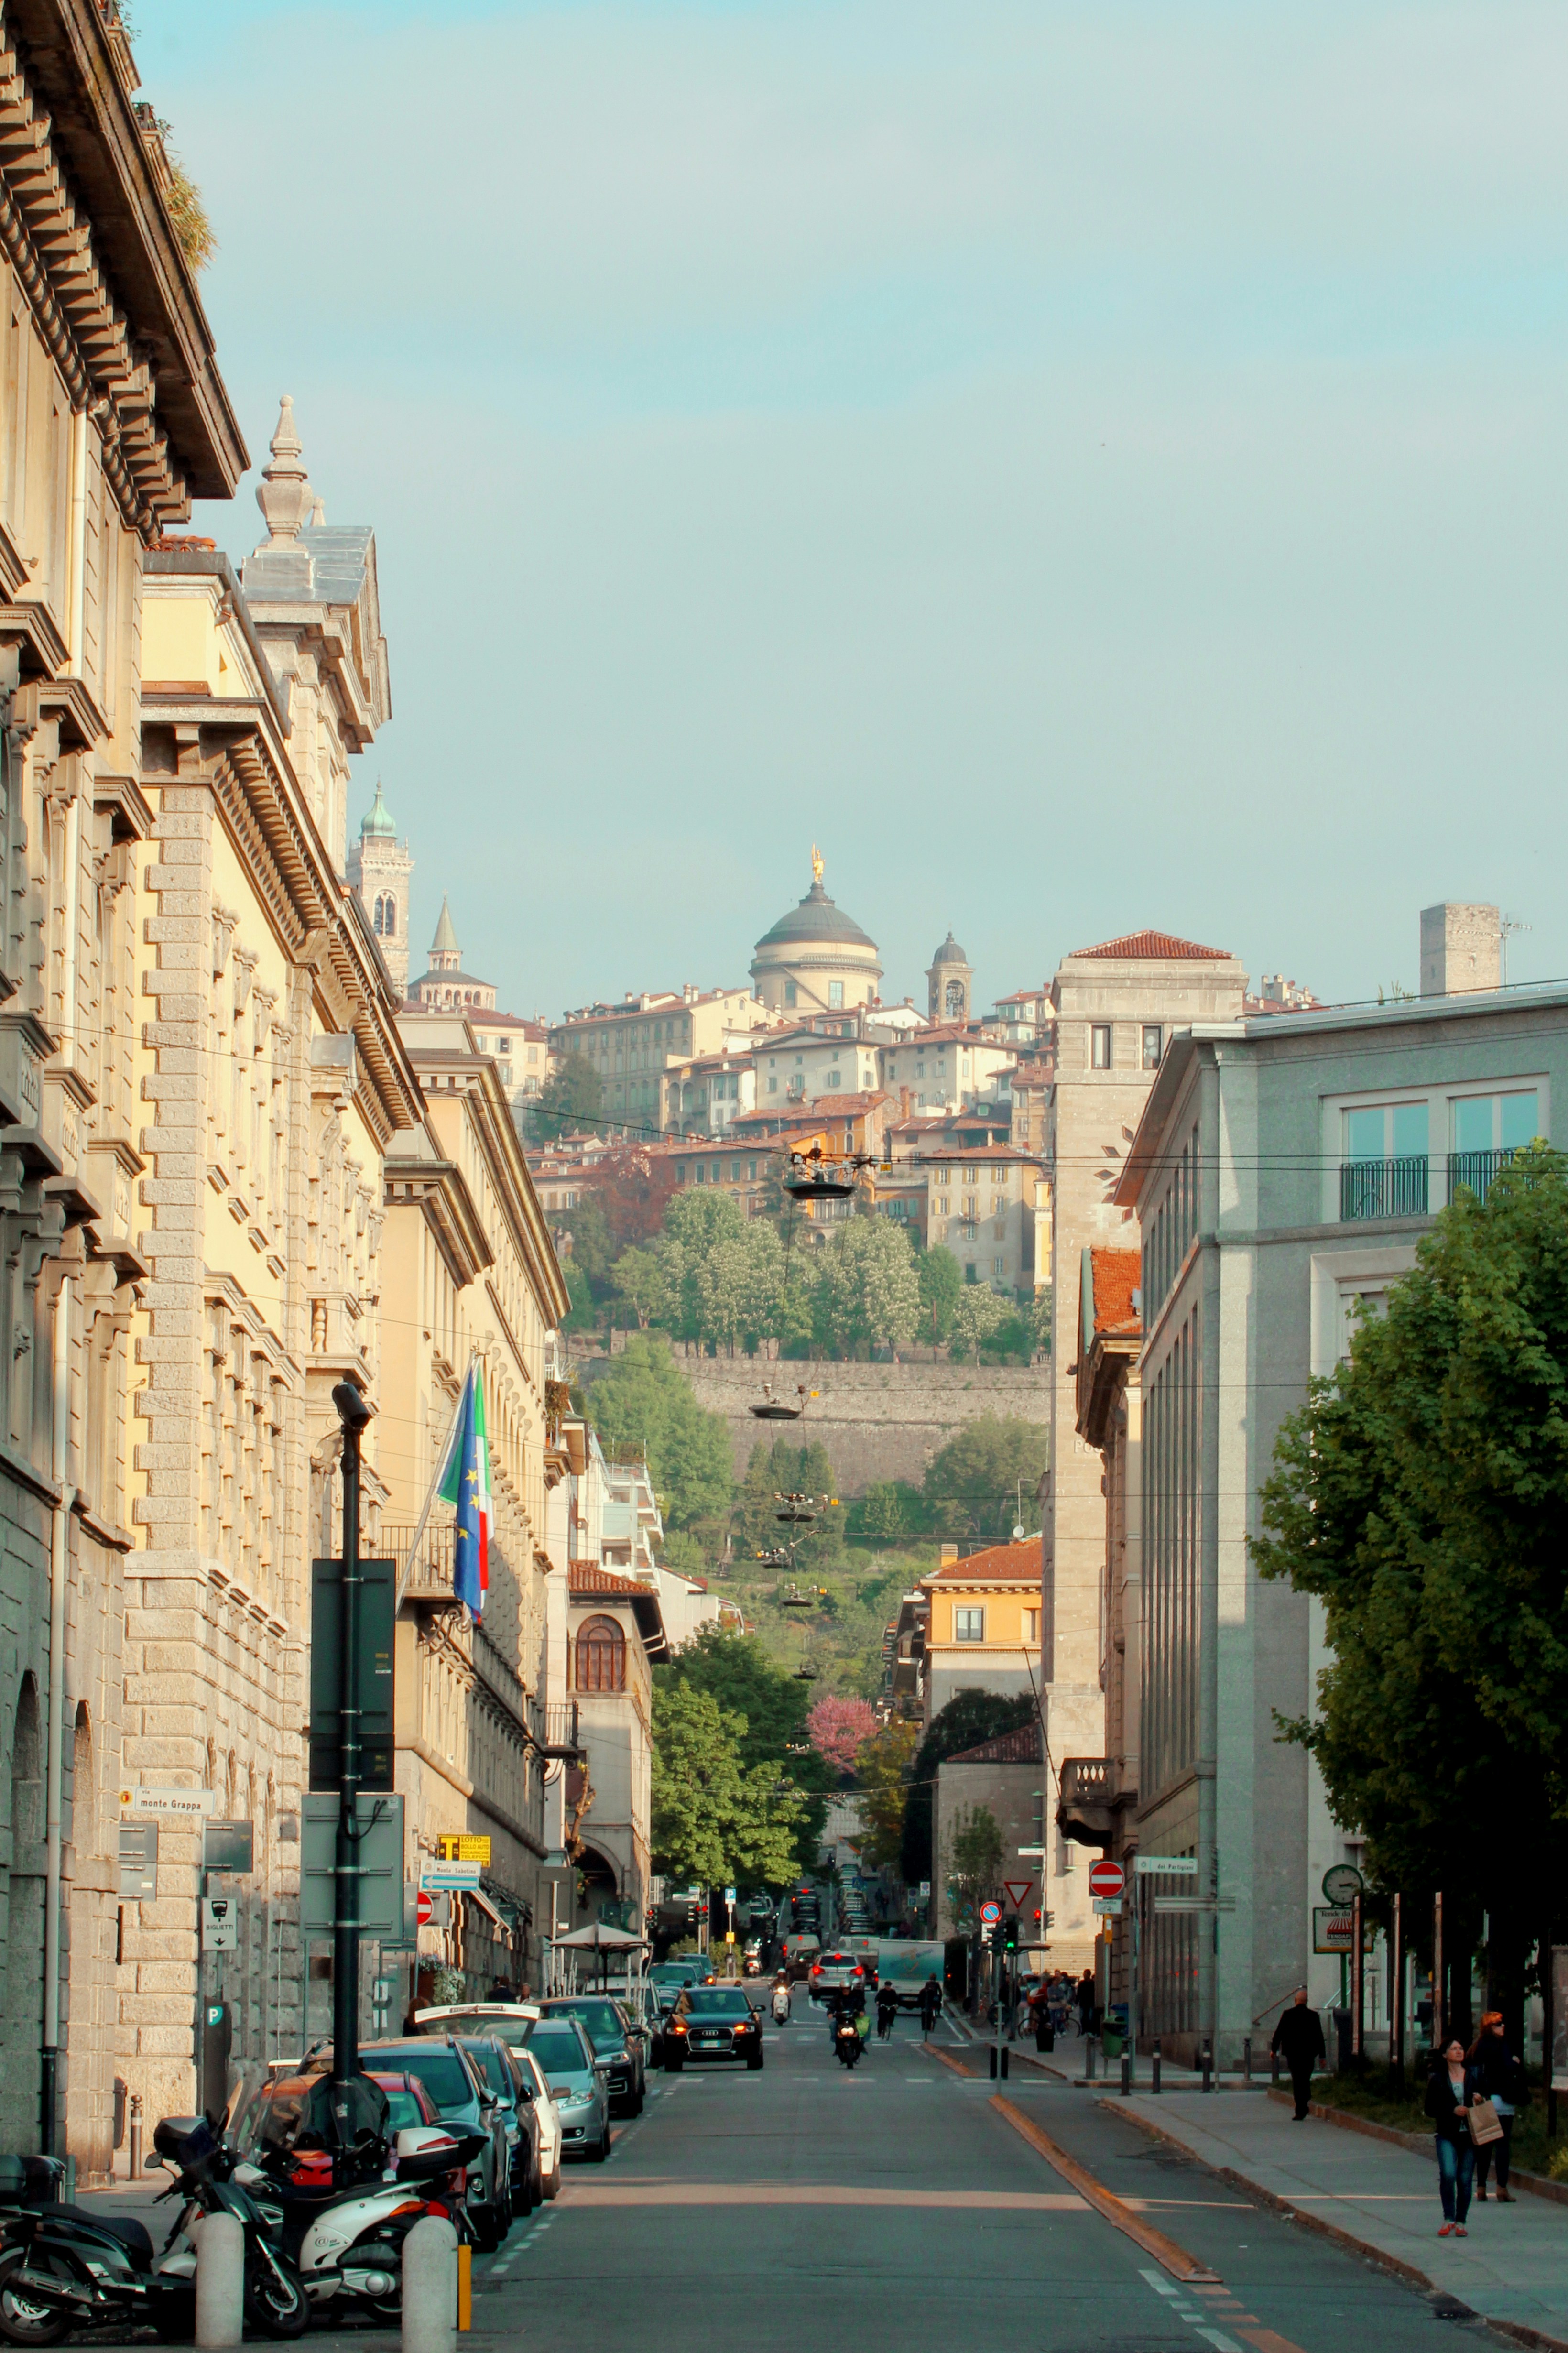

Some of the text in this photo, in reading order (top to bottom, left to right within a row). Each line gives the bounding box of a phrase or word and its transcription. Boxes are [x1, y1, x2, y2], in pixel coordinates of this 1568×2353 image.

[141, 1799, 201, 1811] monte Grappa
[440, 1837, 458, 1861] T
[209, 2008, 218, 2022] P
